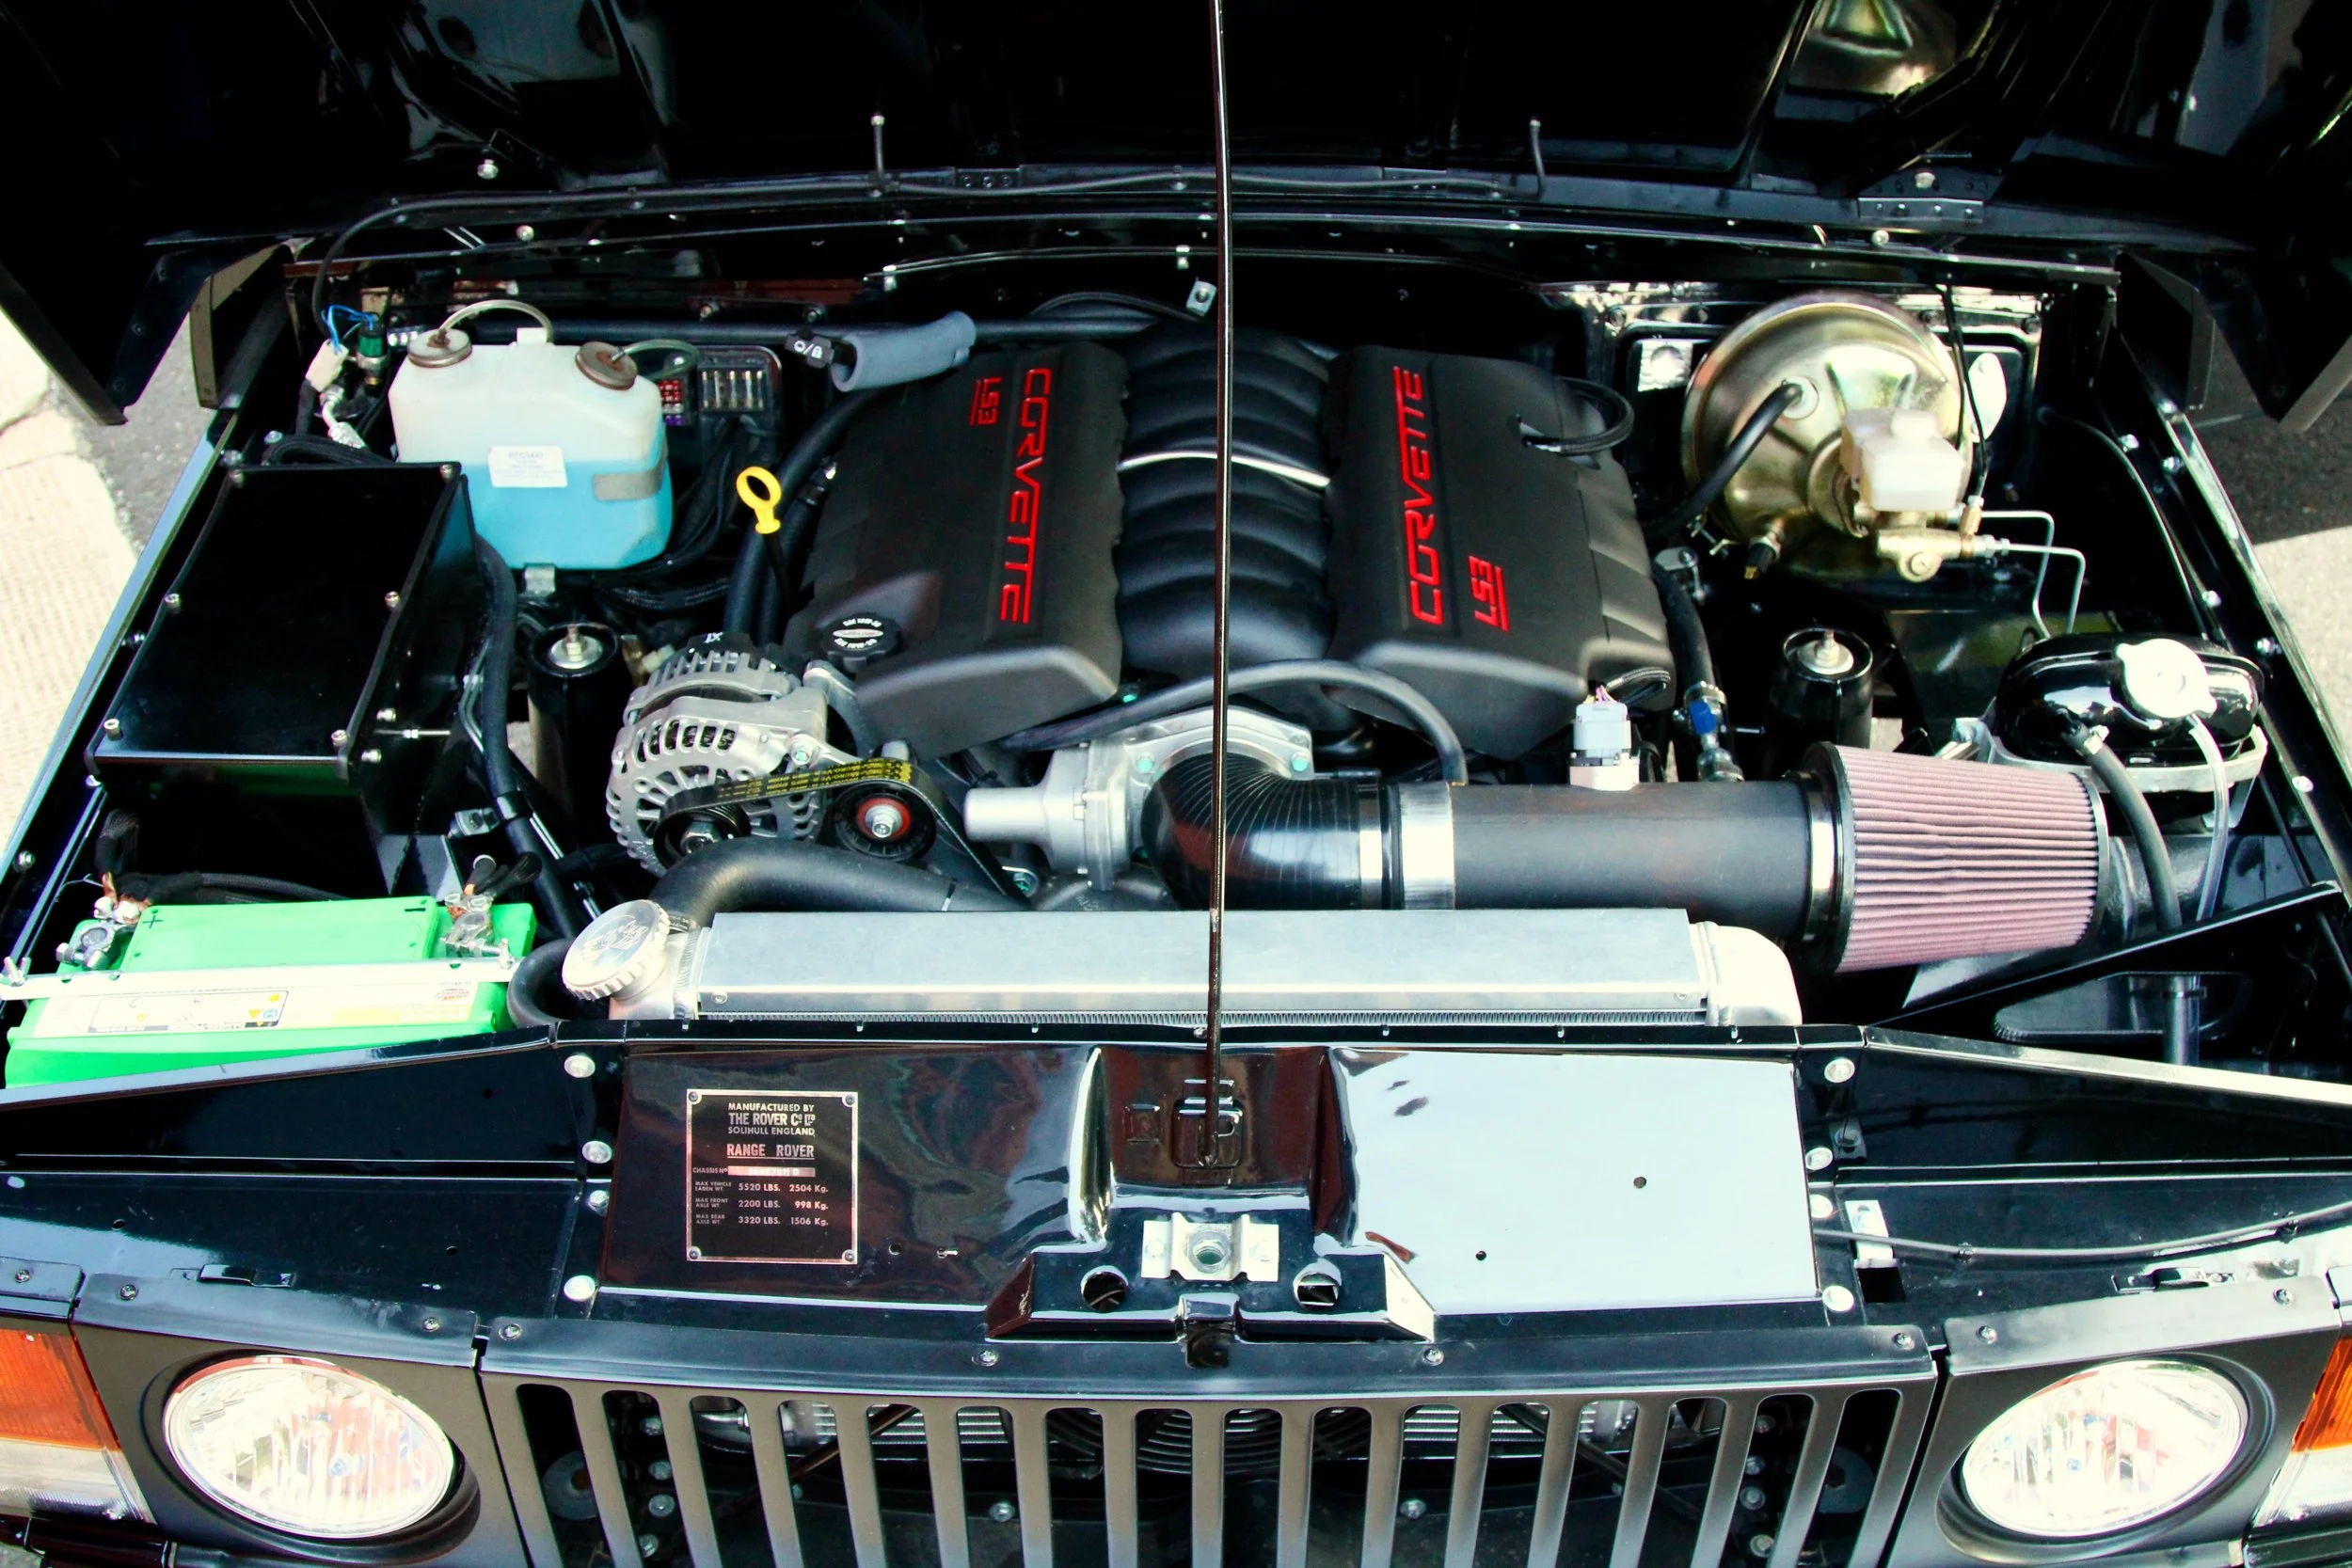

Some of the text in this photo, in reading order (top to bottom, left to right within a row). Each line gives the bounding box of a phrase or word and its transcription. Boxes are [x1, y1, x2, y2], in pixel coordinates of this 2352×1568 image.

[971, 377, 1003, 425] LS3
[999, 368, 1052, 625] CORVETTE
[1392, 365, 1443, 626] CORVETTE
[1468, 555, 1508, 632] LS3
[728, 1102, 800, 1112] MANUFACTURED
[728, 1113, 749, 1125] THE
[753, 1113, 787, 1126] ROVER
[728, 1126, 815, 1136] SOLIHULL ENGLAND
[726, 1144, 815, 1158] RANGE ROVER
[739, 1183, 760, 1192] 5520
[764, 1183, 781, 1192] LBS.
[815, 1184, 829, 1194] Kg.
[739, 1199, 760, 1208] 2200
[764, 1200, 781, 1209] LBS.
[815, 1201, 829, 1211] Kg.
[739, 1215, 829, 1227] 3320 LBS. 1506 Kg.
